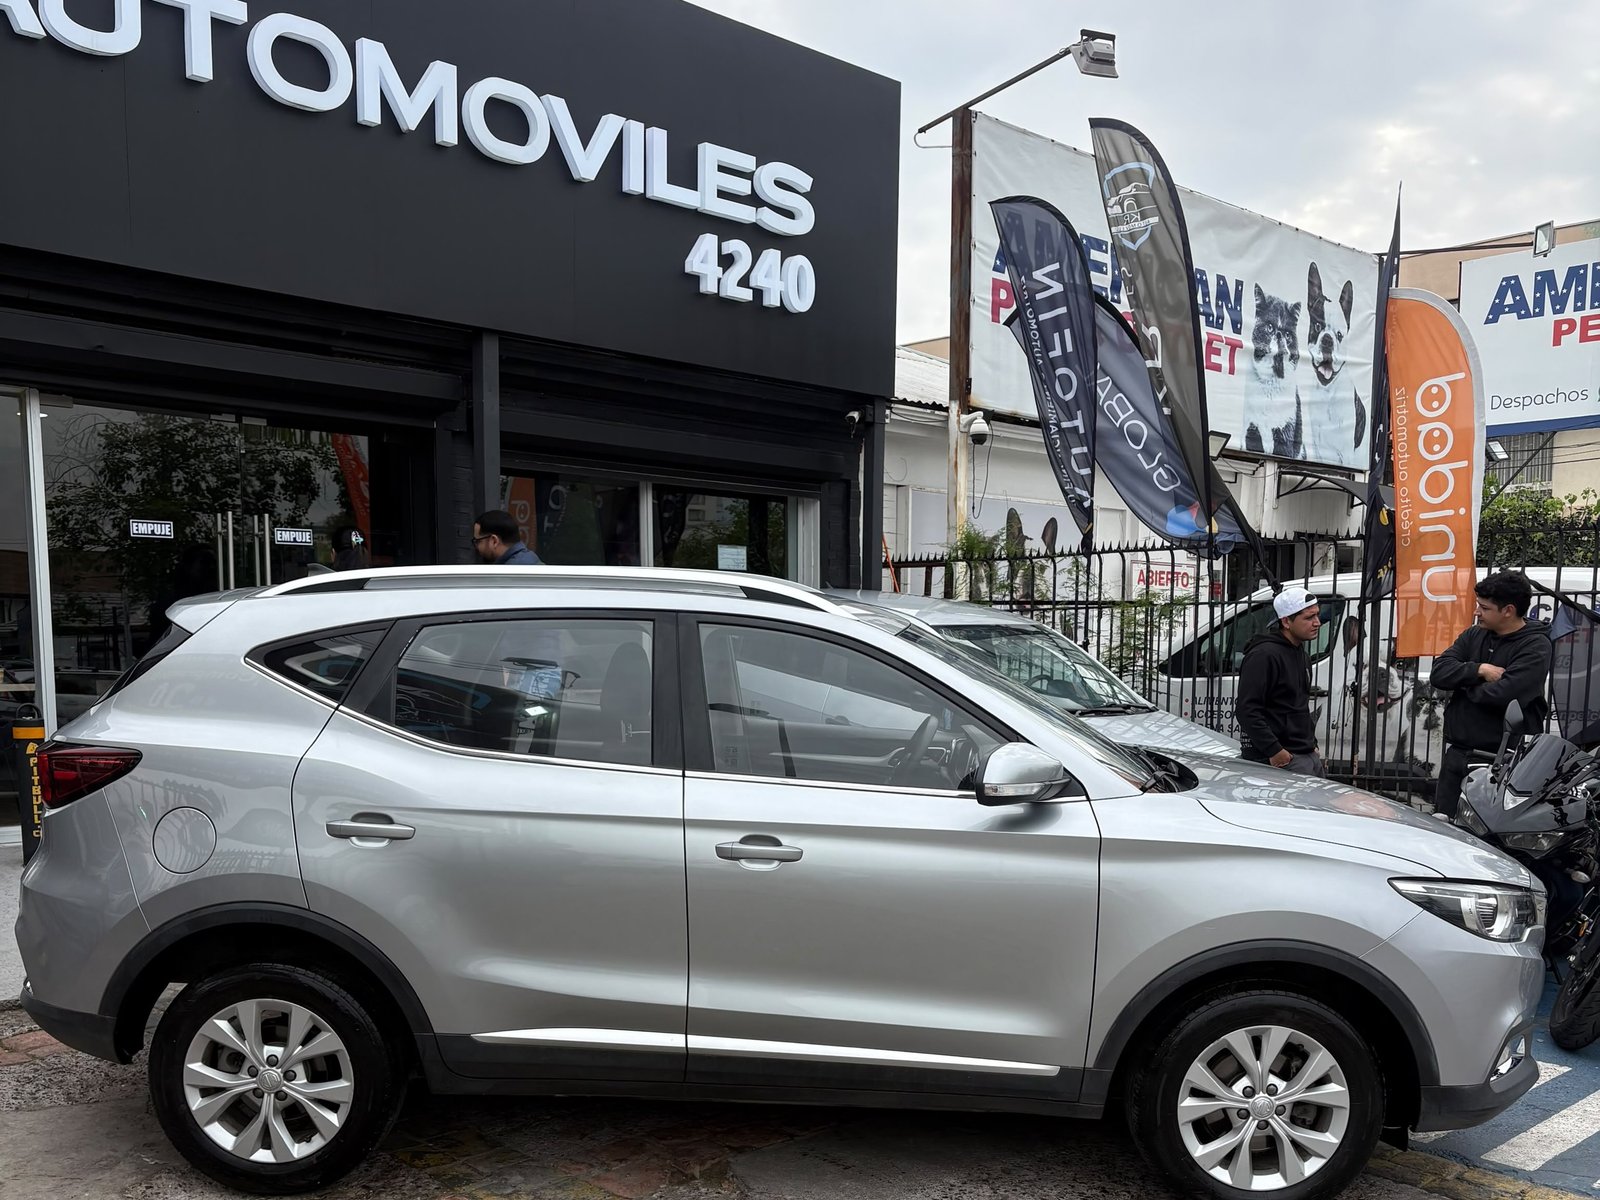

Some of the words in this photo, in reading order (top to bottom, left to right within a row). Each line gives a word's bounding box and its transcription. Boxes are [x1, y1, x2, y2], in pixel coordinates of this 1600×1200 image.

[685, 232, 817, 314] 4240
[1490, 387, 1589, 411] Despachos
[132, 521, 172, 536] EMPUJE
[276, 530, 312, 543] EMPUJE
